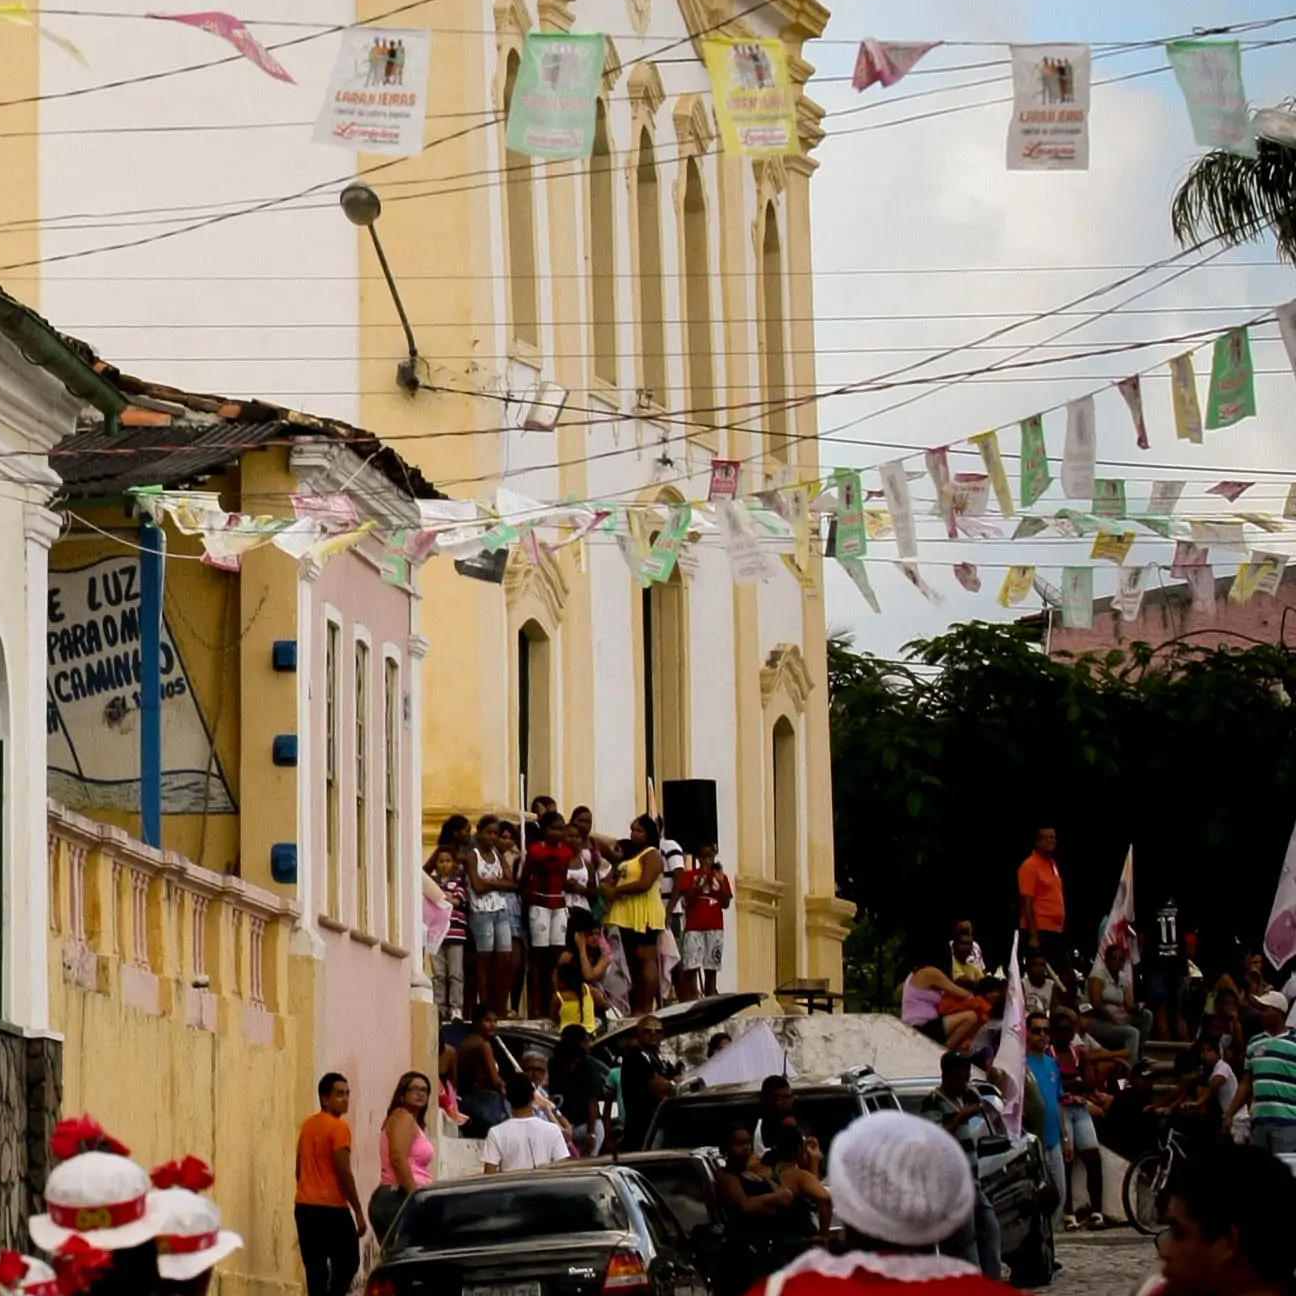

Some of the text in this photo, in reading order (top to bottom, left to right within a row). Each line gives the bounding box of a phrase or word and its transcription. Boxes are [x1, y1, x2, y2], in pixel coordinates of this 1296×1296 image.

[335, 91, 416, 106] LARANJEIRAS
[87, 565, 142, 611] LUZ
[47, 619, 103, 665] PARA
[103, 614, 119, 647] O
